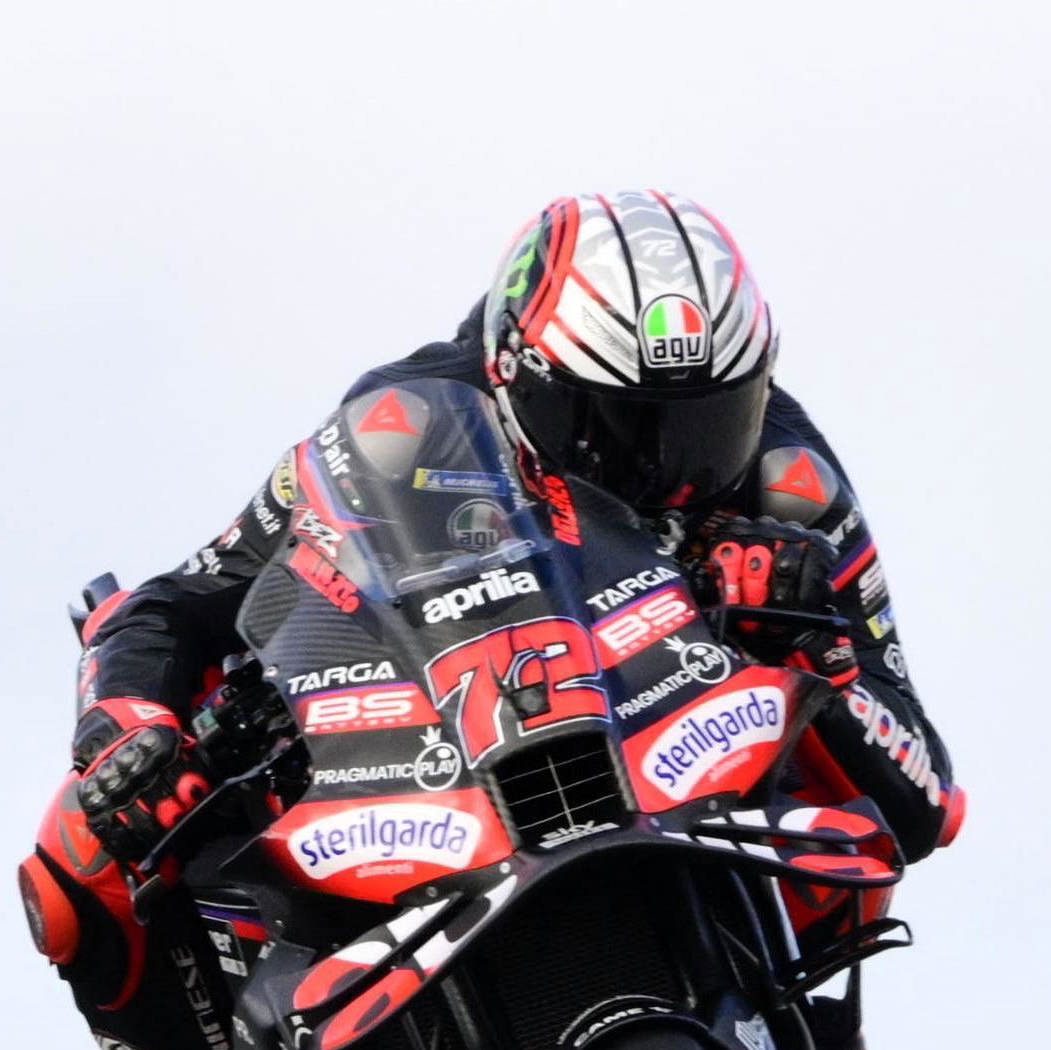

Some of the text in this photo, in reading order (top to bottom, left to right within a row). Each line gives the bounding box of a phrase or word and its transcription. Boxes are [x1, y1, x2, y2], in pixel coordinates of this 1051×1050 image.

[640, 240, 677, 256] 72
[653, 334, 702, 363] agv
[421, 567, 541, 624] aprilia
[585, 566, 681, 612] TARGA
[596, 591, 688, 651] BS
[287, 660, 397, 695] TARGA
[423, 615, 613, 770] 72
[613, 650, 725, 720] PRAGMATIC PLAY
[304, 689, 418, 726] BS
[653, 691, 779, 788] sterilgarda
[847, 683, 941, 807] aprilia
[313, 759, 456, 786] PRAGMATIC PLAY
[300, 809, 469, 867] sterilgarda
